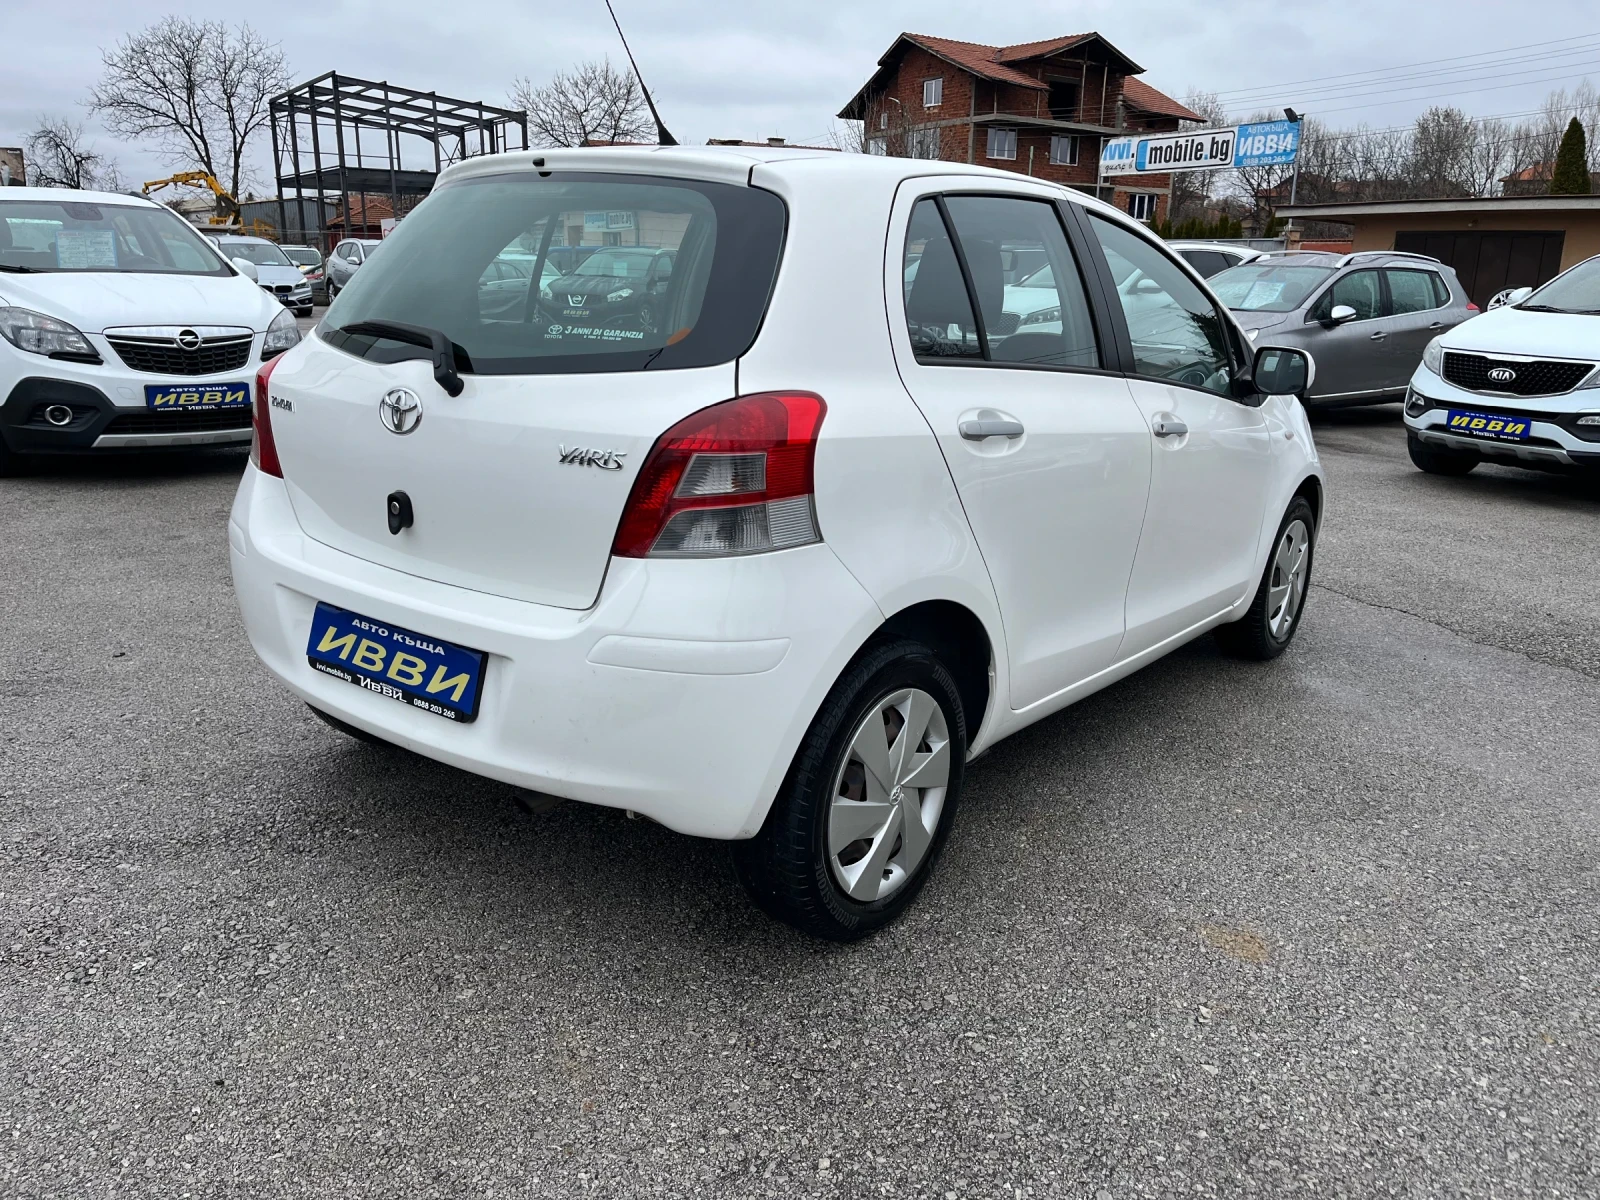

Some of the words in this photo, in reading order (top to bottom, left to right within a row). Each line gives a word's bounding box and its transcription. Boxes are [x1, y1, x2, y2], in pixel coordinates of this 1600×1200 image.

[1148, 136, 1231, 165] mobile.bg
[1238, 133, 1293, 157] ИВВИ
[1242, 157, 1259, 165] 0888
[1272, 155, 1286, 163] 265
[565, 325, 572, 334] 3
[572, 327, 592, 335] ANNI
[593, 328, 603, 336] DI
[603, 329, 644, 339] GARANZIA
[1490, 369, 1510, 381] KIA
[153, 390, 245, 406] ИВВИ
[1450, 415, 1526, 434] ИВВИ
[351, 618, 389, 637] АВТО
[393, 633, 446, 656] КЪЩА
[316, 625, 471, 703] ИВВИ
[316, 662, 352, 682] ivvi.mobile.bg
[413, 698, 430, 710] 0888
[430, 703, 442, 715] 203
[443, 708, 456, 719] 265
[932, 665, 965, 739] BRIDGESTONE
